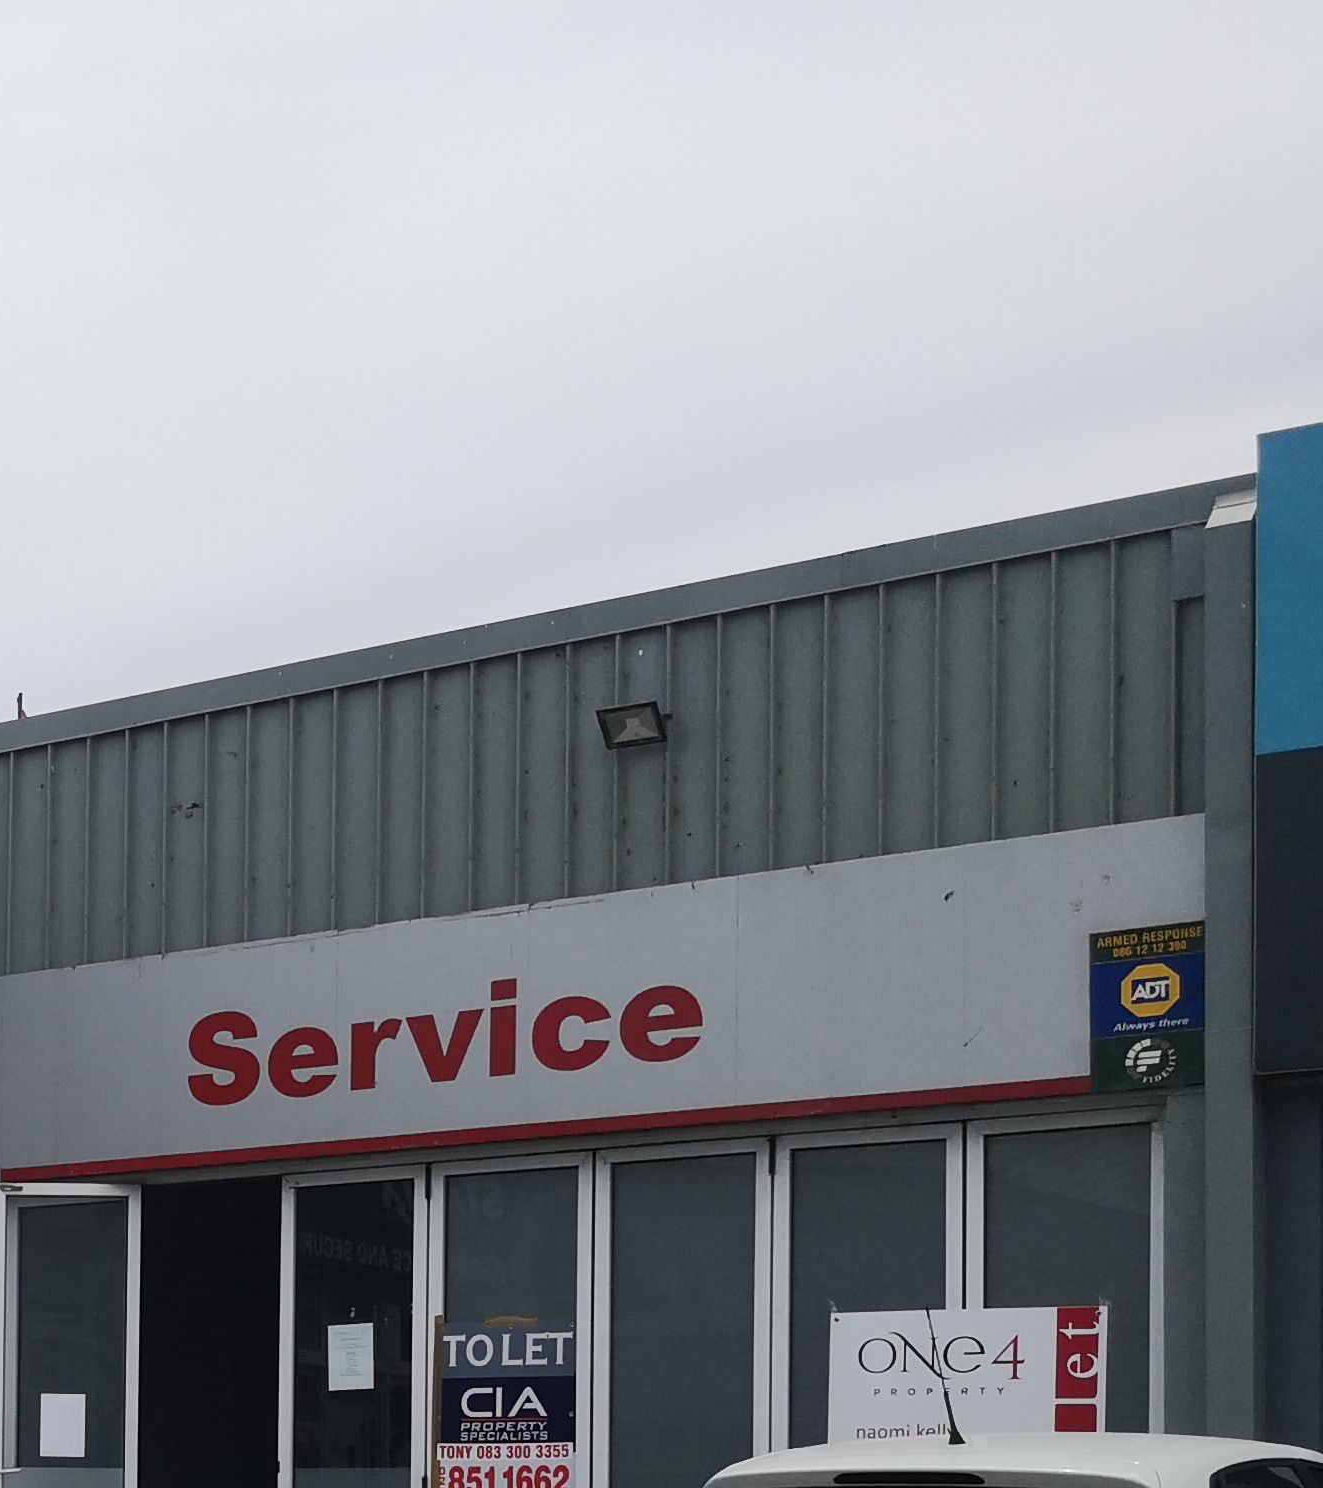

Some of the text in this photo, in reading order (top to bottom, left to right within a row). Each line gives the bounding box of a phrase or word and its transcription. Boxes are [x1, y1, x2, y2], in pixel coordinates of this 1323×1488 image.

[1097, 926, 1204, 949] ARMED RESPONSE
[1131, 980, 1170, 1001] ADT
[1114, 1017, 1190, 1032] Always there
[187, 978, 704, 1106] Service
[442, 1331, 574, 1367] TO LET
[873, 1387, 1005, 1396] PROPERTY
[460, 1386, 548, 1418] CIA
[460, 1421, 548, 1432] PROPERTY
[856, 1424, 911, 1439] naomi
[459, 1431, 549, 1441] SPECIALISTS
[439, 1444, 569, 1459] TONY 083 300 3355
